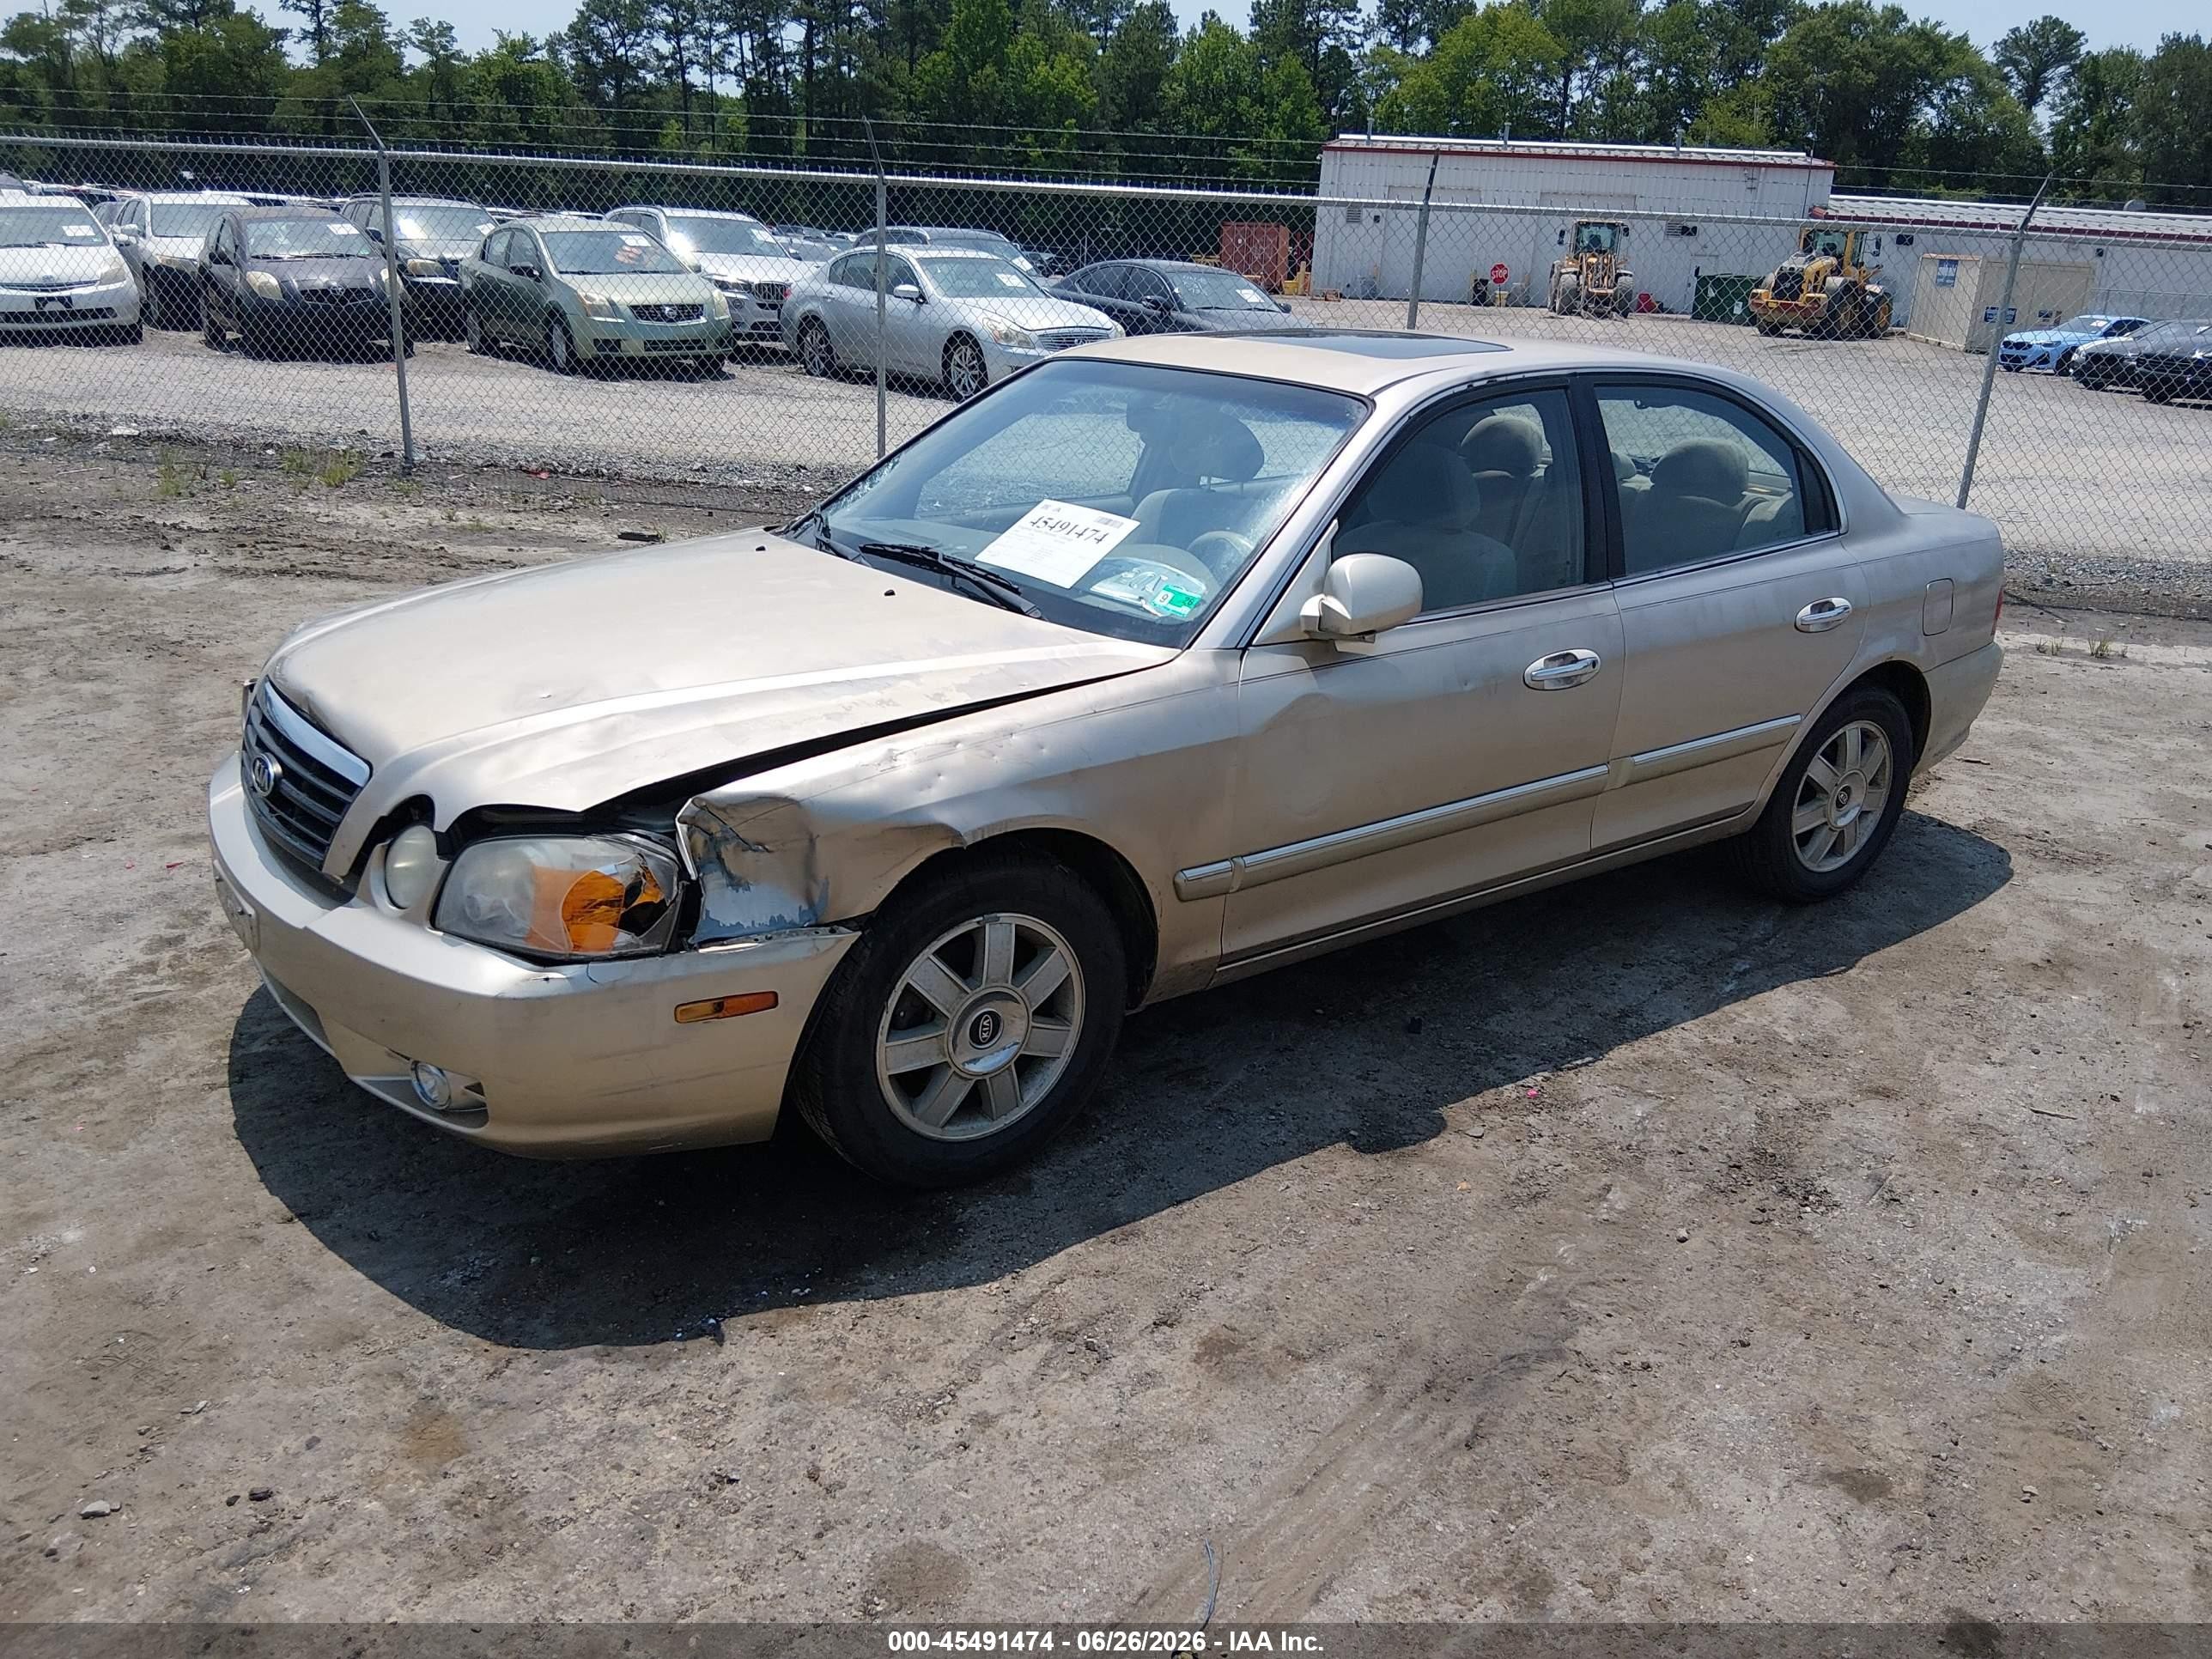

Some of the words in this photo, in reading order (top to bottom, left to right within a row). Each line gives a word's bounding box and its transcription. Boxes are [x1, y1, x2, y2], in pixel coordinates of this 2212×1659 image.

[1491, 270, 1507, 279] STOP
[1030, 515, 1109, 544] 45491474
[1159, 593, 1169, 604] 9
[1182, 597, 1195, 606] 26
[981, 1018, 990, 1038] KIA
